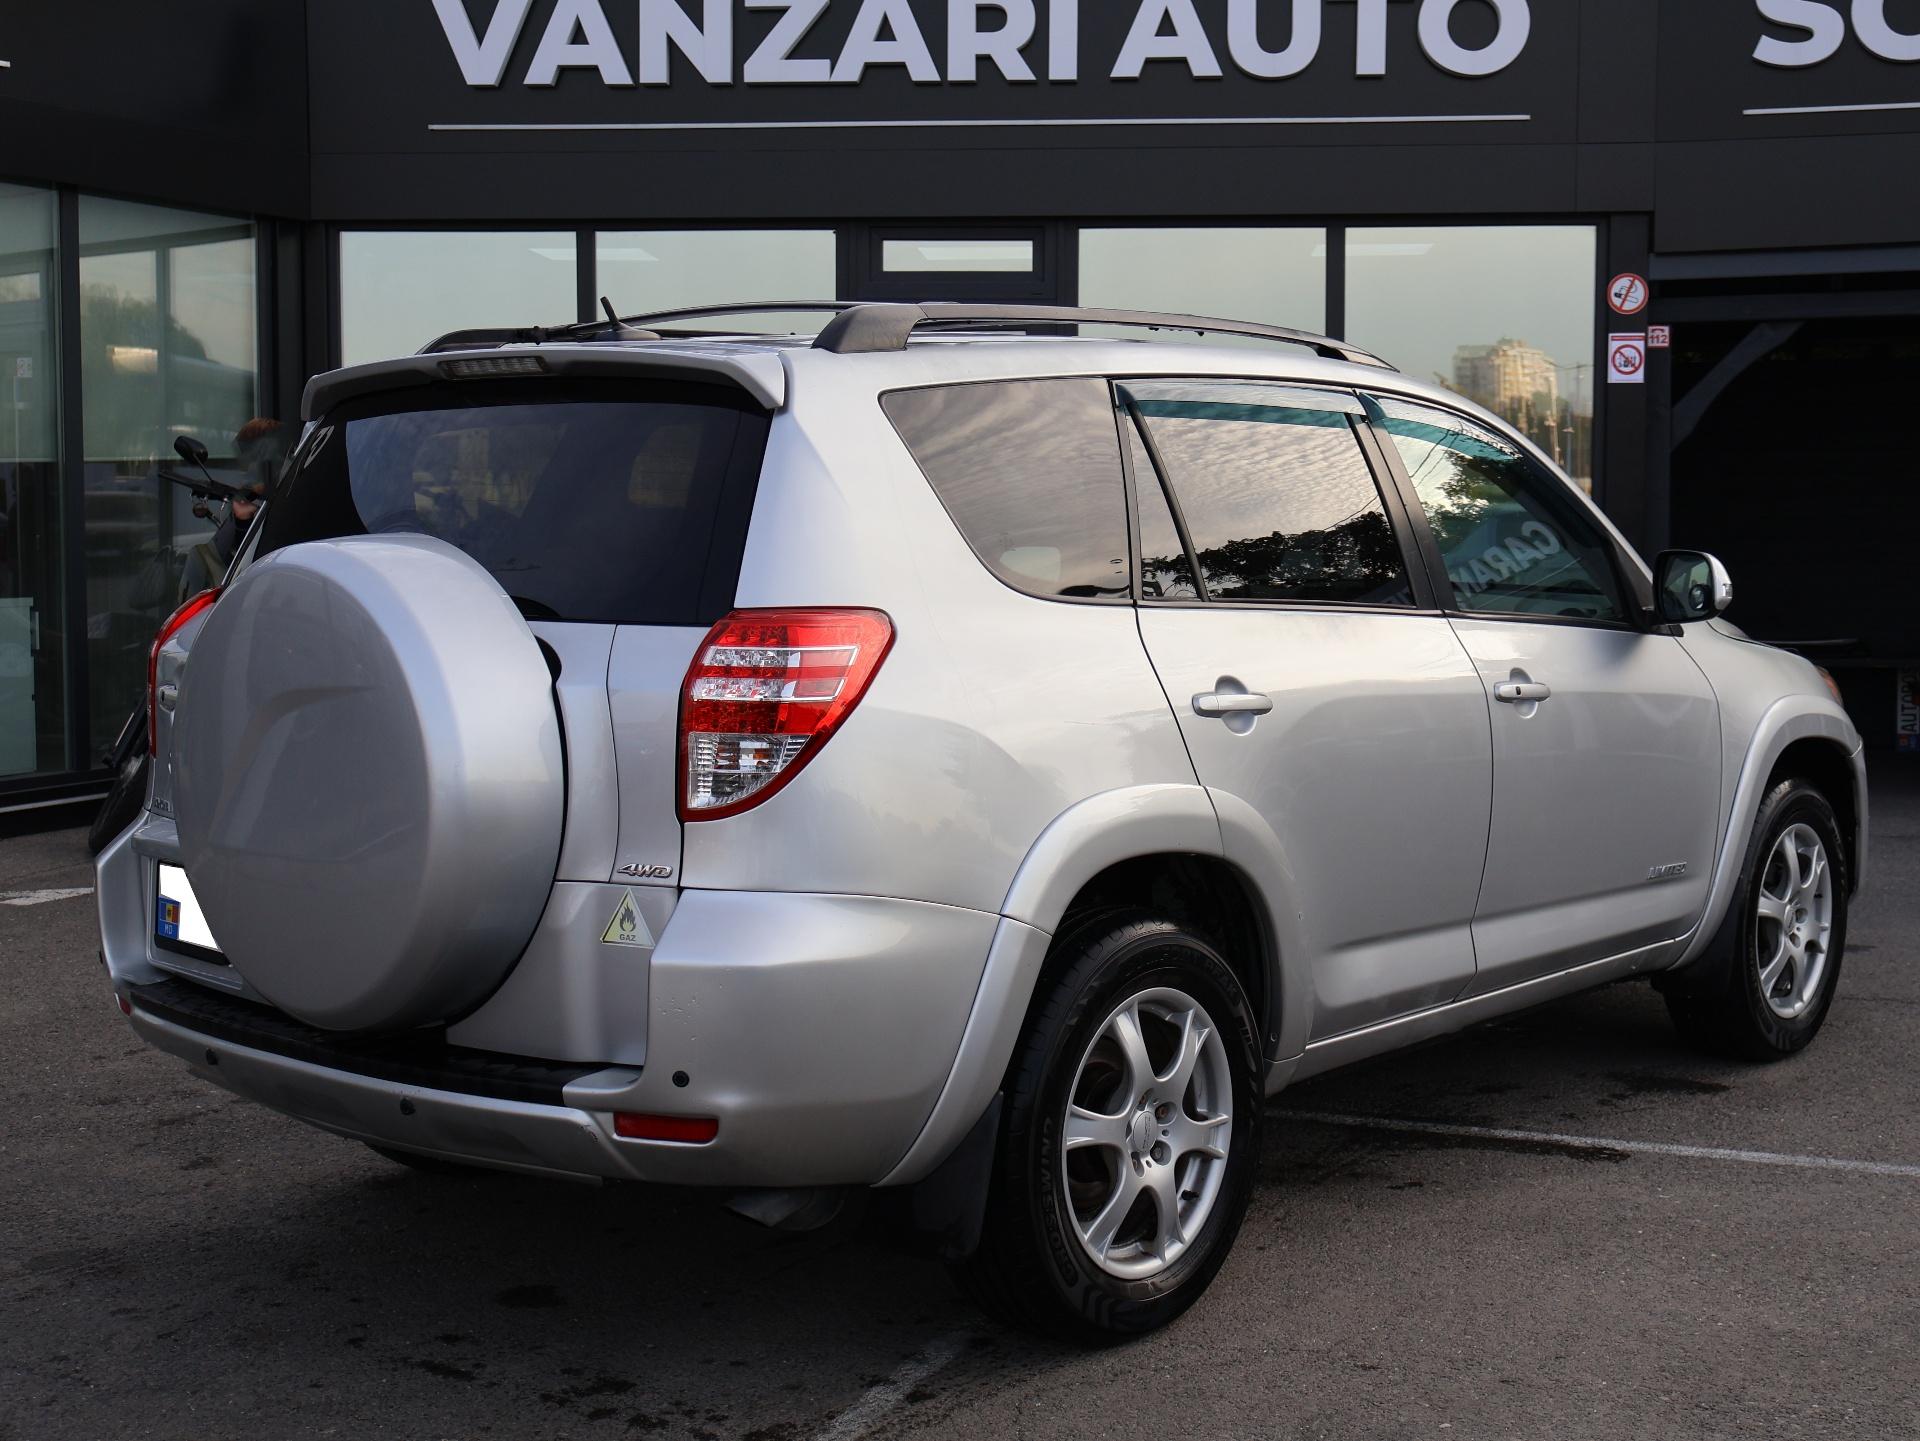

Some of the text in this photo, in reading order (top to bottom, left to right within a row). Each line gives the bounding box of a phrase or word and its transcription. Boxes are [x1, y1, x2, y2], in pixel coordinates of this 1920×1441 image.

[431, 0, 1531, 87] VANZARI AUTO
[1648, 334, 1668, 344] 112
[617, 863, 673, 878] 4WD
[164, 923, 173, 935] MD
[619, 933, 637, 942] GAZ
